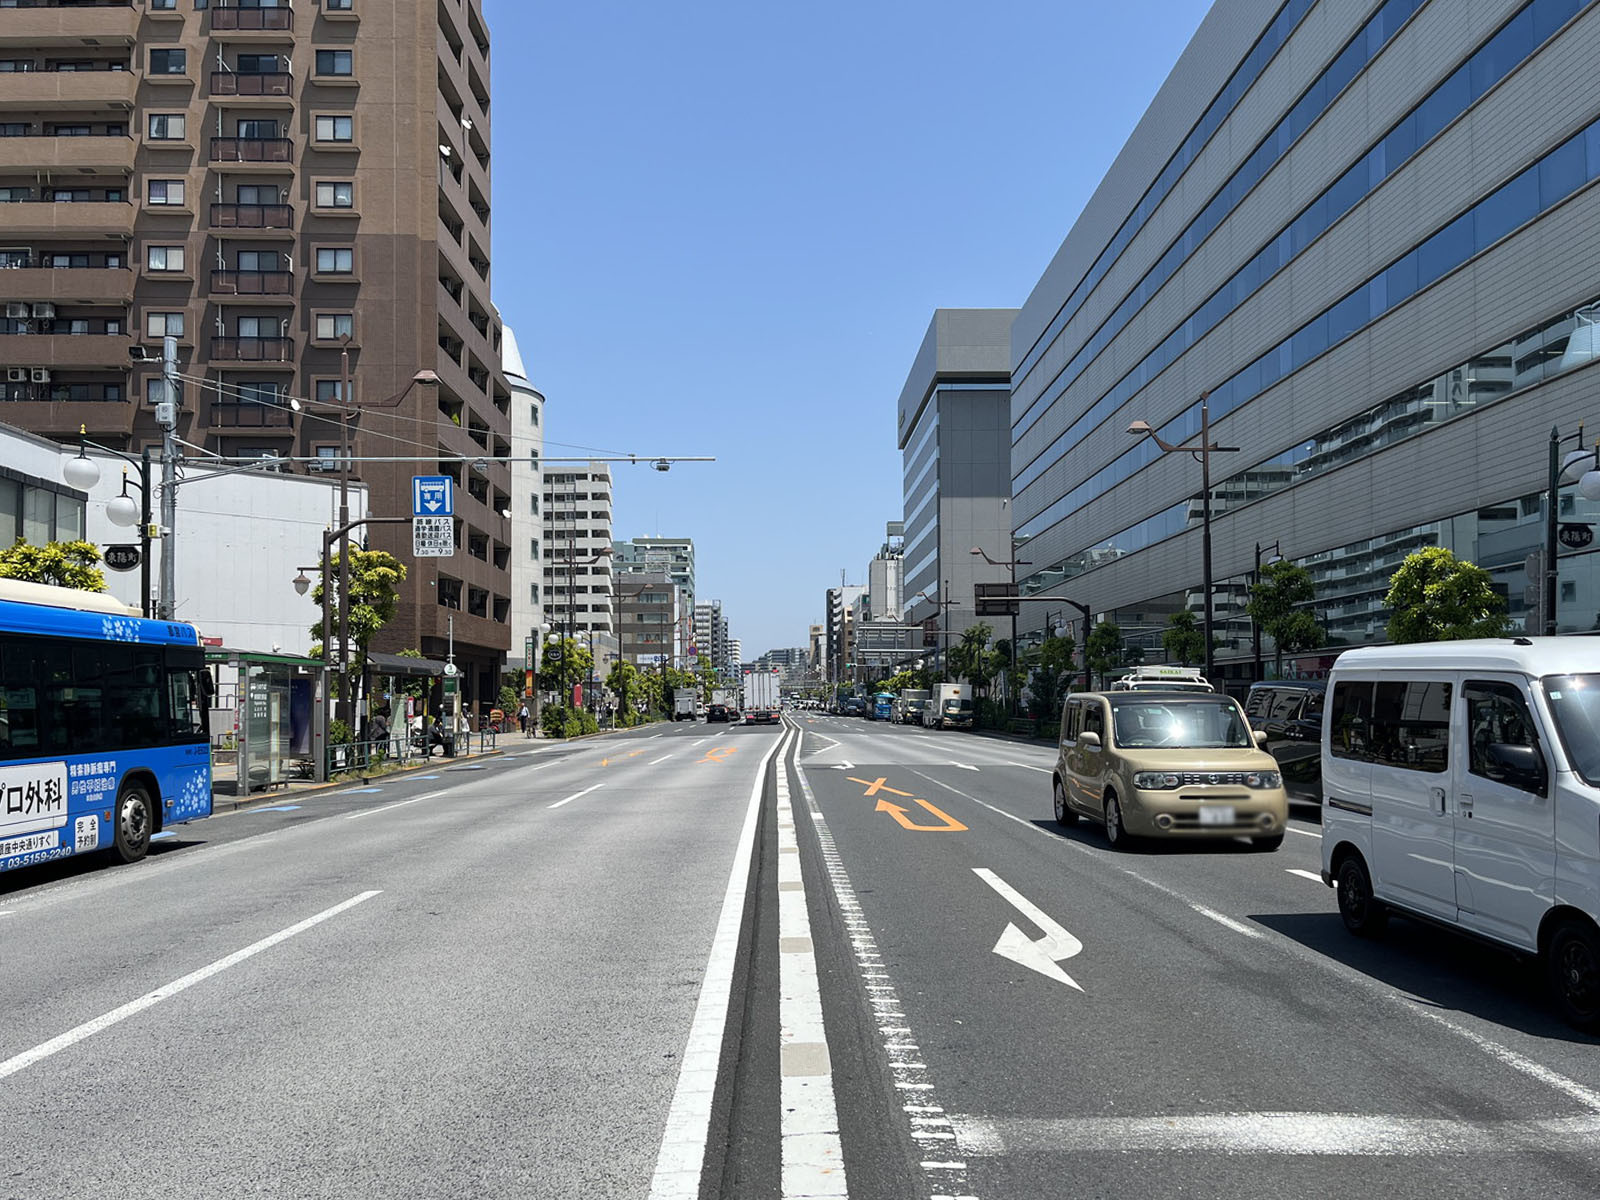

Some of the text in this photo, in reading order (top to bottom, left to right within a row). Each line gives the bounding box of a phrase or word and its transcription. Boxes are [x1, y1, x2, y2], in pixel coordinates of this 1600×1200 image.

[1561, 529, 1591, 542] 東陽町
[107, 552, 137, 564] 東陽町
[7, 846, 73, 869] 03-5159-2240
